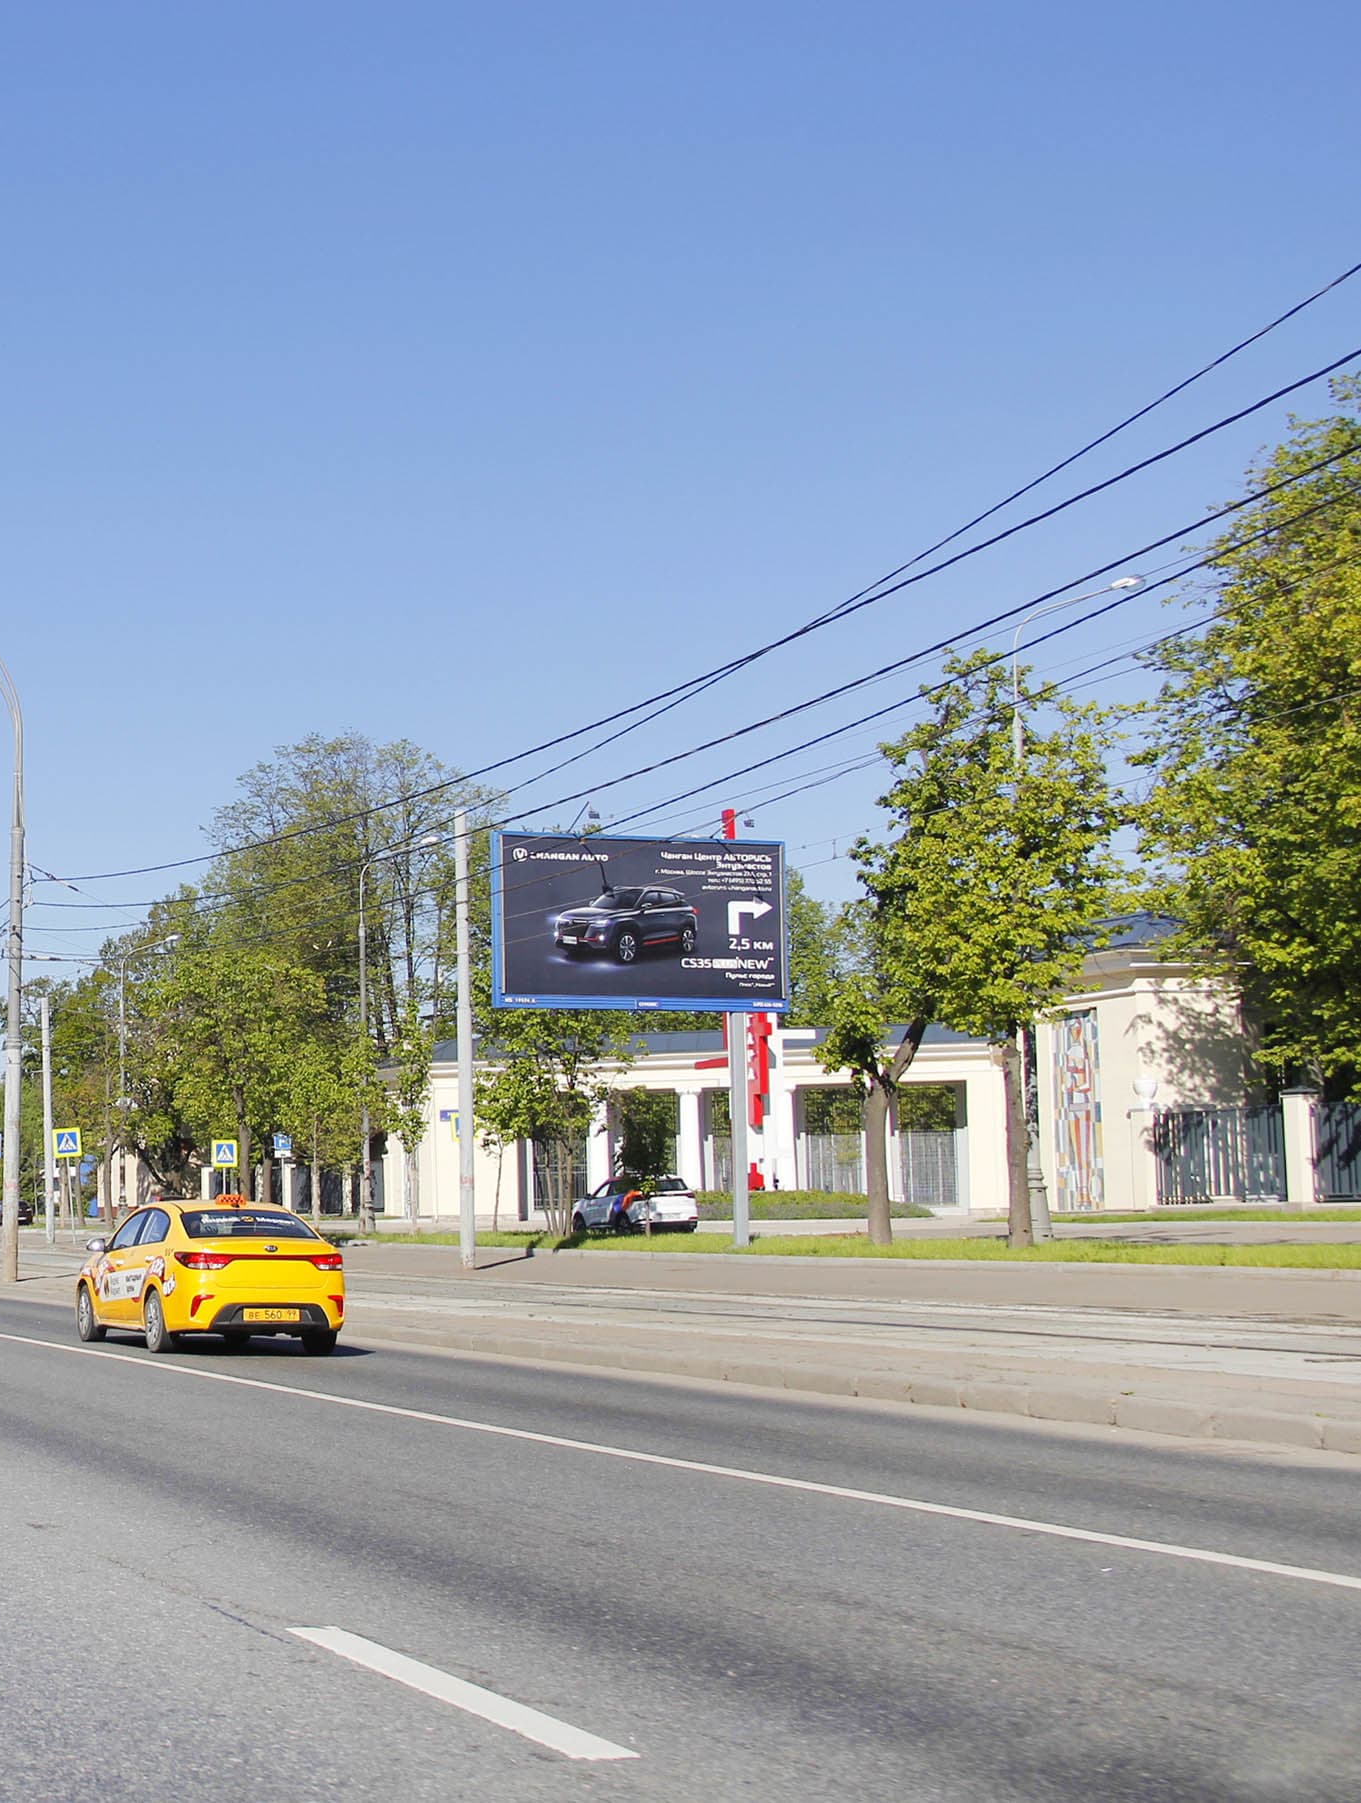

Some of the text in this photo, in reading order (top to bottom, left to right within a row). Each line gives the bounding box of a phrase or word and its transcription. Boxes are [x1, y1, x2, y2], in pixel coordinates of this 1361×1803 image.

[694, 852, 722, 862] Центр
[728, 938, 750, 951] 2,5
[681, 957, 712, 969] CS35
[264, 1310, 282, 1320] 560
